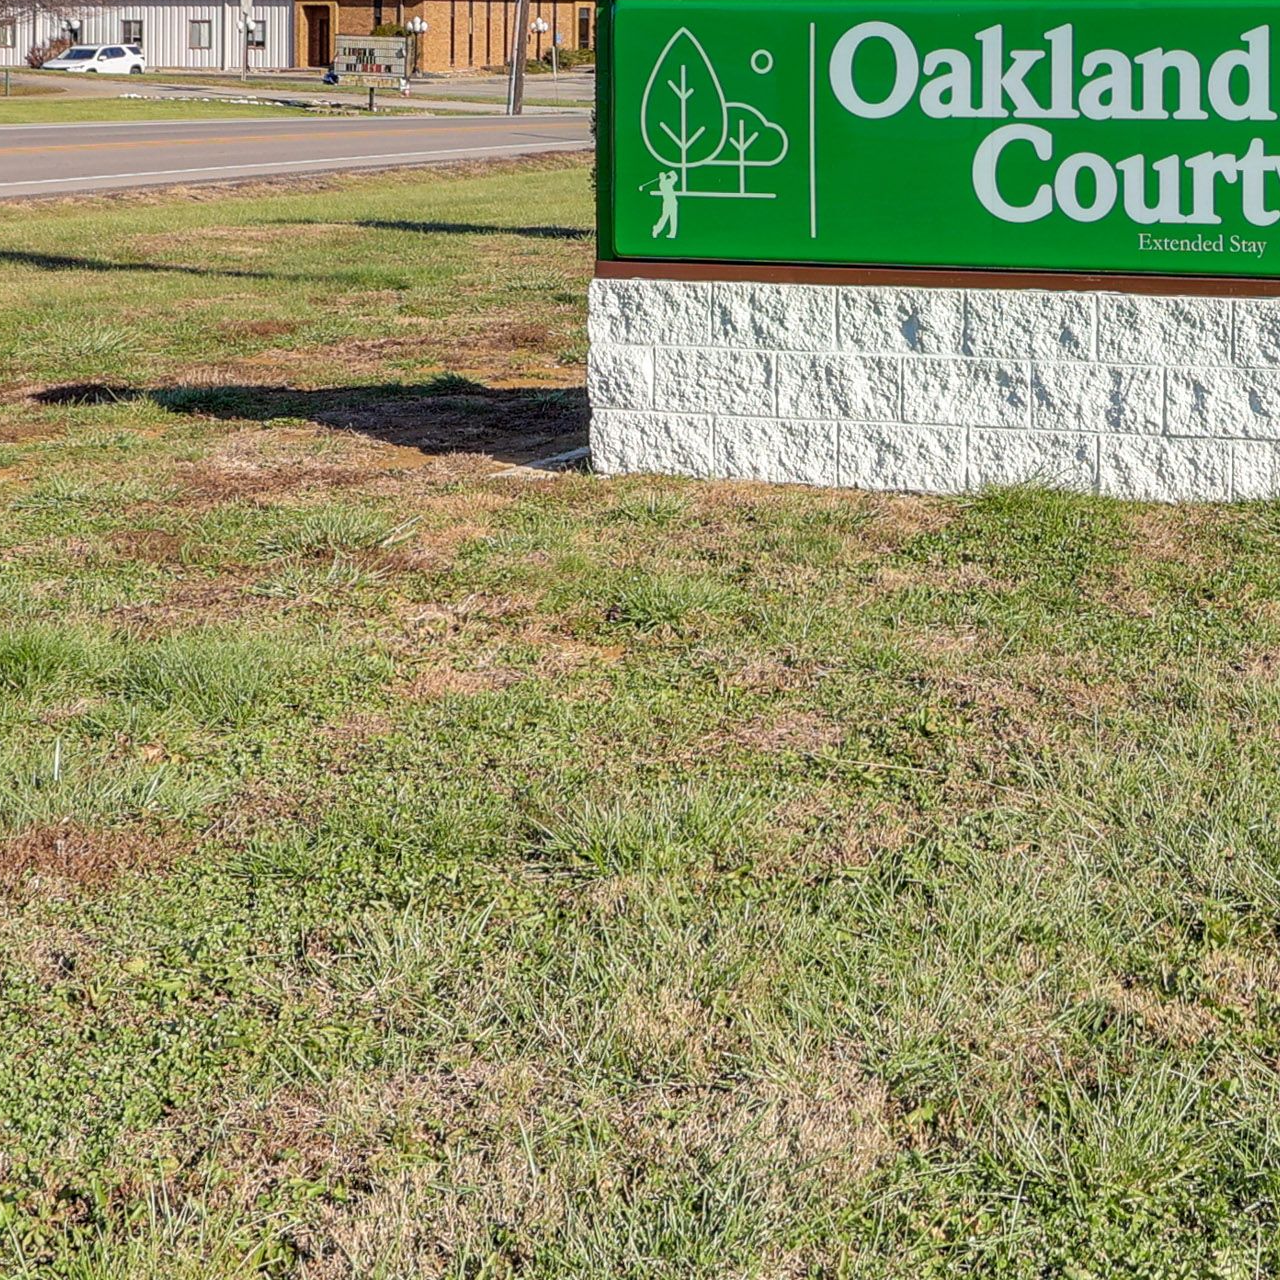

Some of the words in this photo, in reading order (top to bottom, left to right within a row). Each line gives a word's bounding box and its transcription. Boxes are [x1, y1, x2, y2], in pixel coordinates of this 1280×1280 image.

[828, 20, 1278, 121] Oakland
[1138, 233, 1223, 252] Extended
[1229, 235, 1267, 258] Stay
